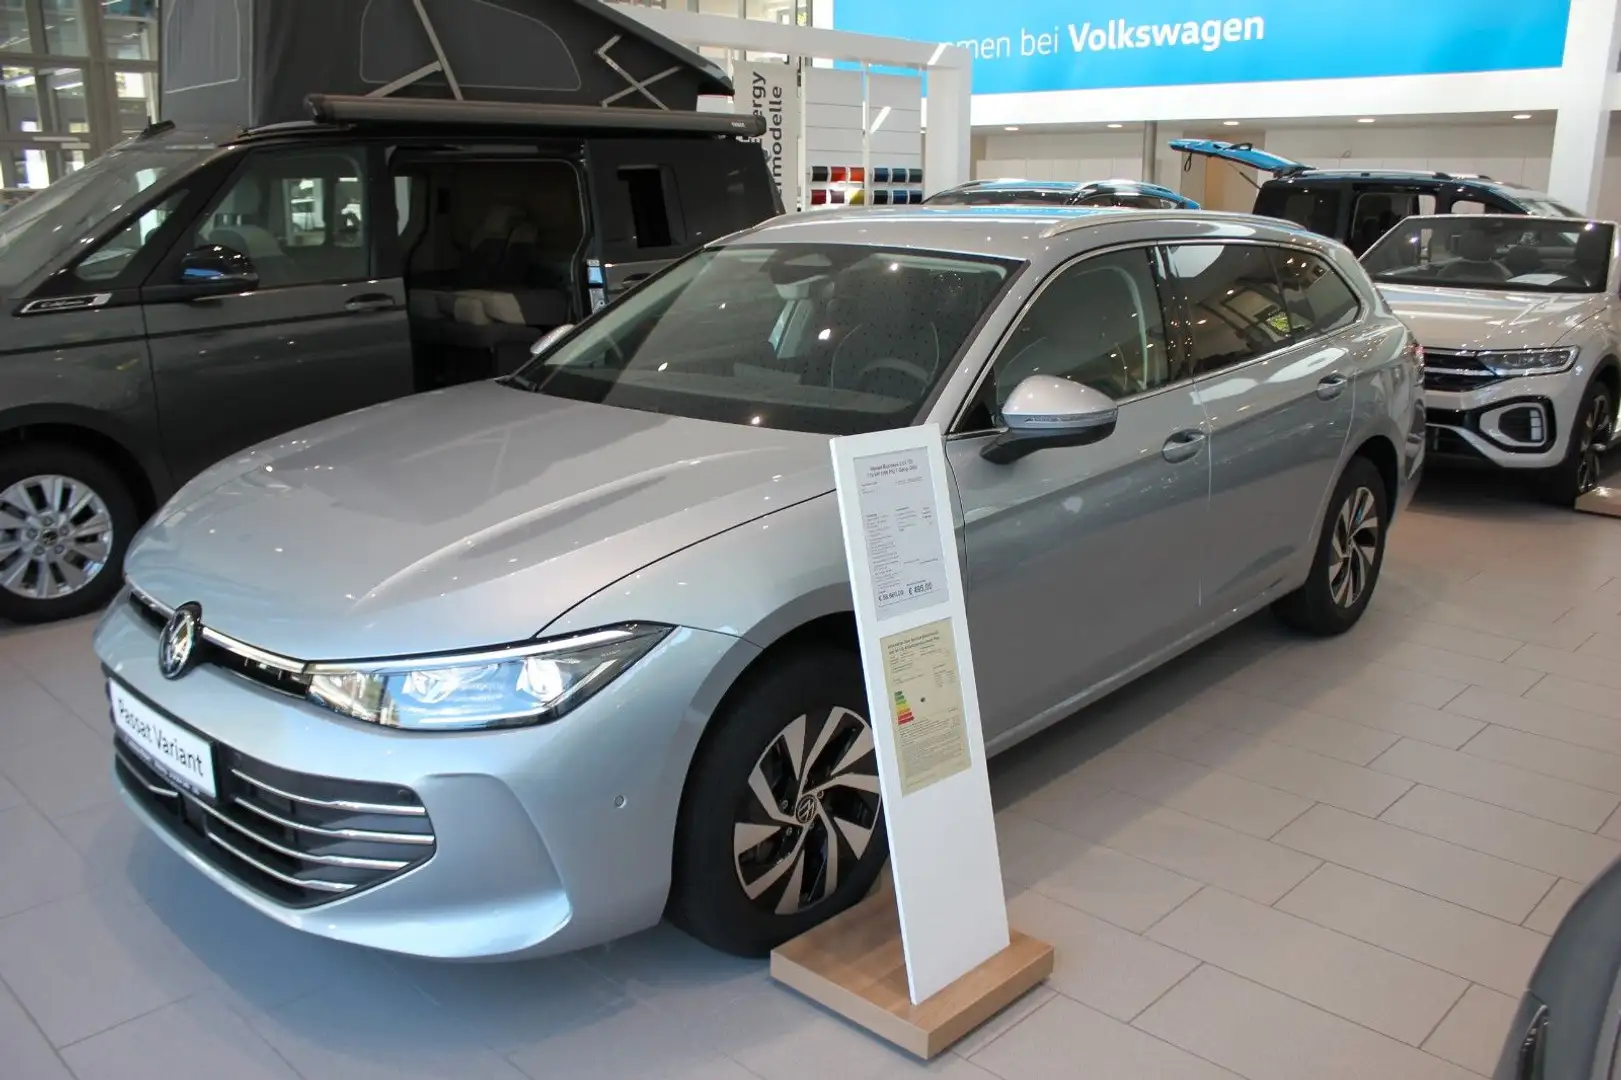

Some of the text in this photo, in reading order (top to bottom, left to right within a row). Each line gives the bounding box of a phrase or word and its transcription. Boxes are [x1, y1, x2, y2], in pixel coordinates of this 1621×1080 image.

[946, 15, 1265, 60] men bei Volkswagen
[117, 698, 153, 743] Passat
[152, 723, 204, 777] Variant
